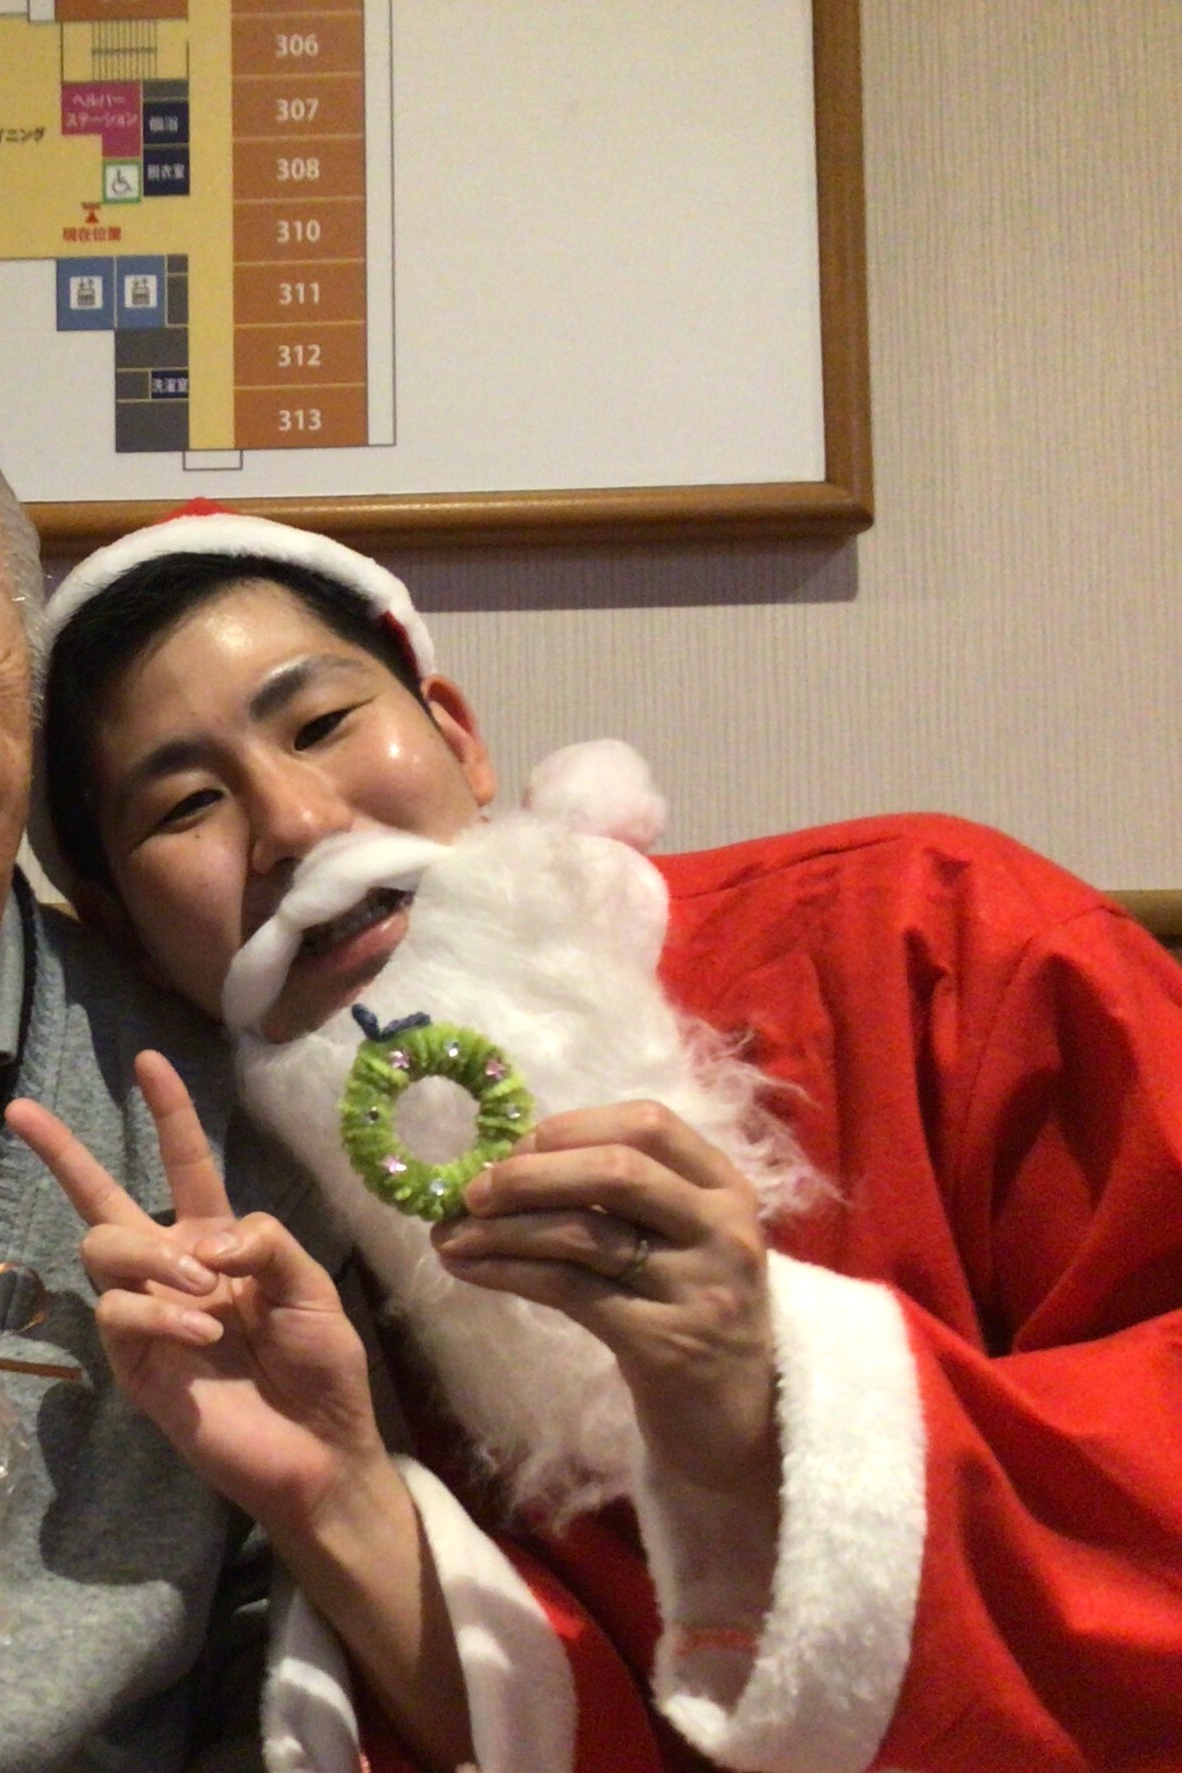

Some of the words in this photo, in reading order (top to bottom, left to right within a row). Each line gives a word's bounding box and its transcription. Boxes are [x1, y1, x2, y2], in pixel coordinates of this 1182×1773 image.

[277, 33, 319, 57] 306
[277, 98, 319, 122] 307
[277, 157, 320, 181] 308
[277, 219, 321, 243] 310
[278, 282, 320, 305] 311
[278, 344, 321, 367] 312
[278, 408, 322, 432] 313
